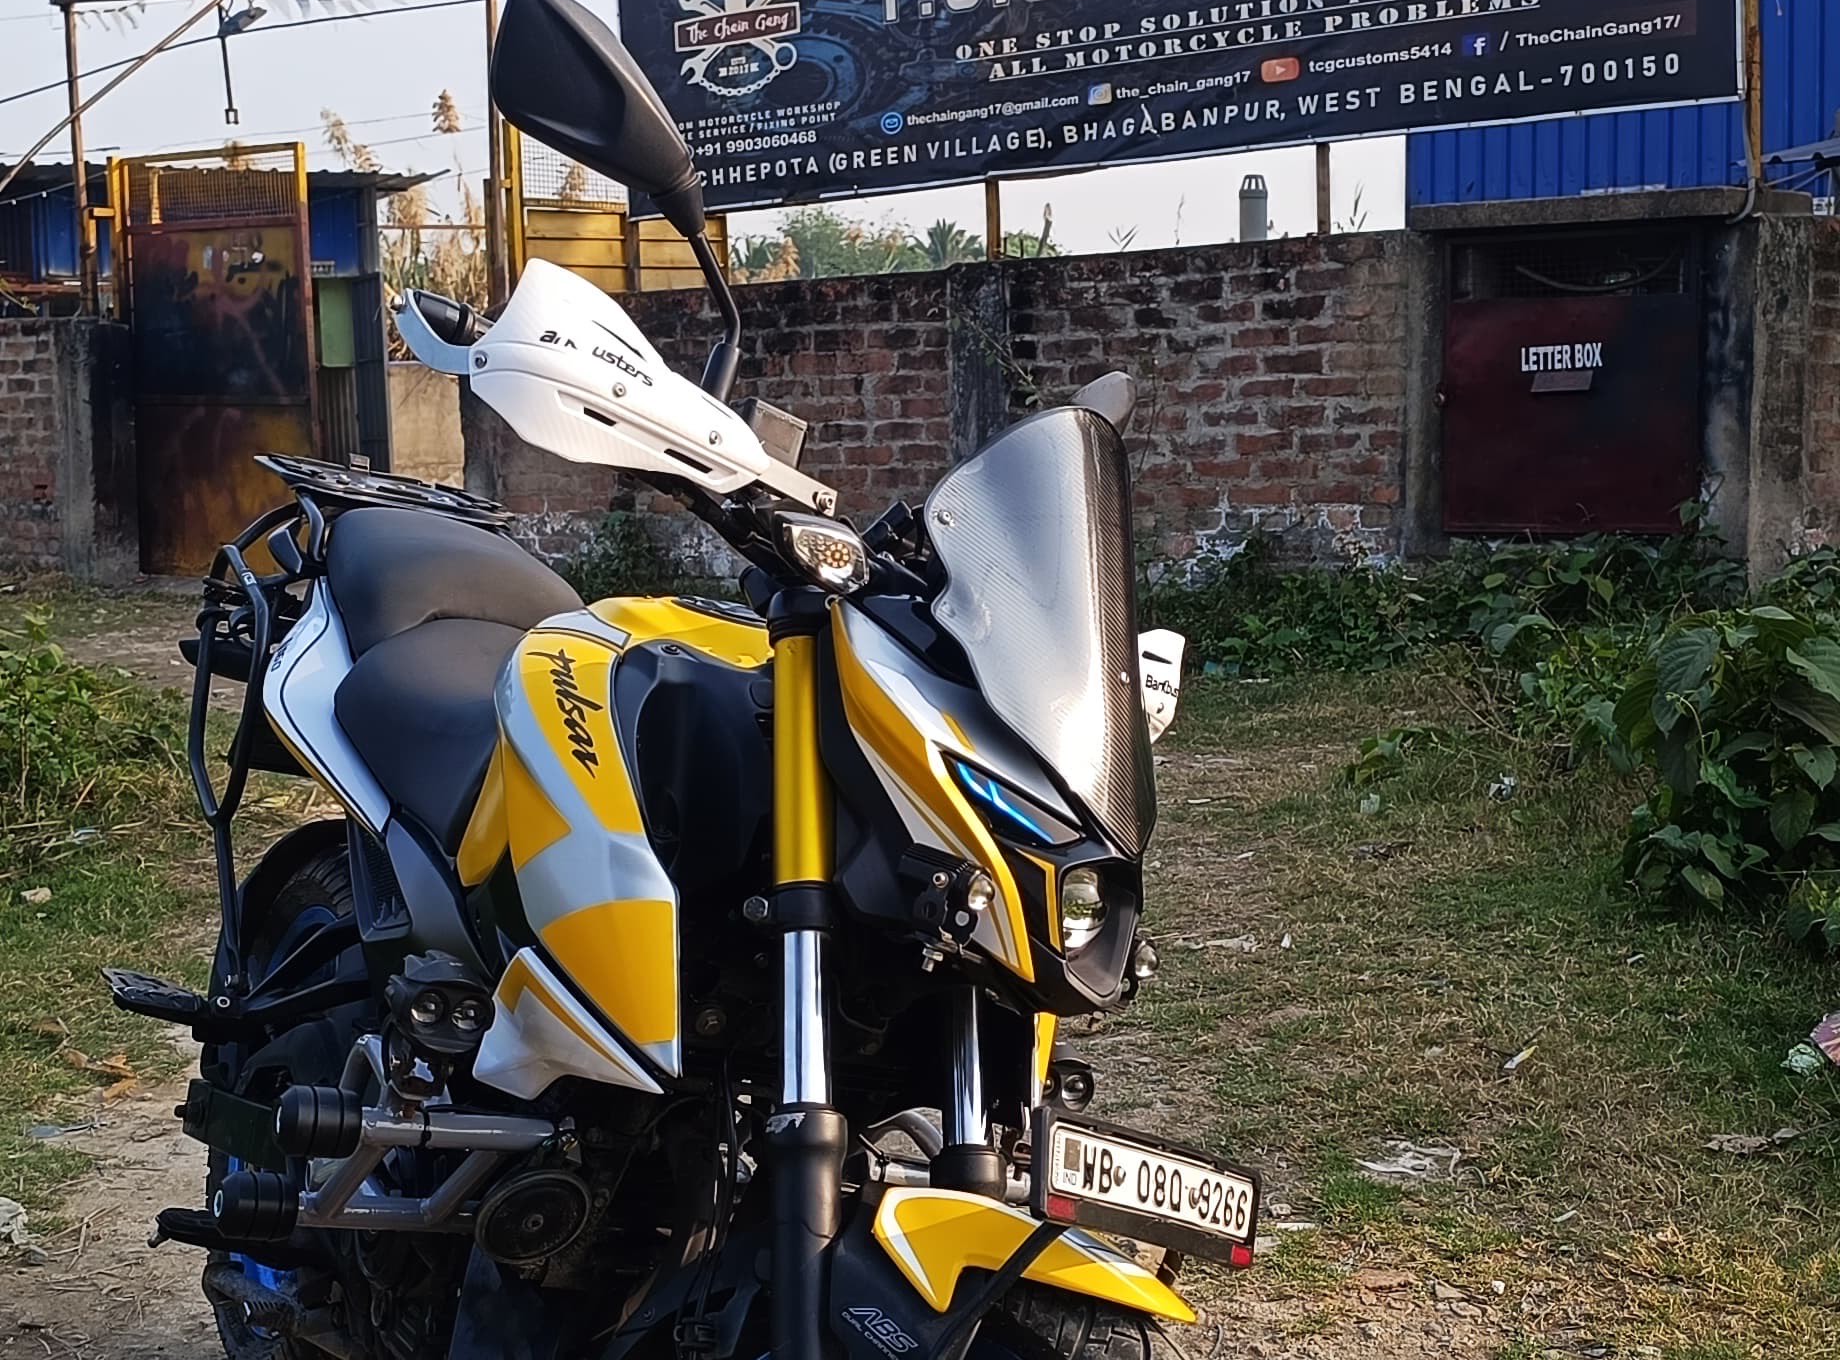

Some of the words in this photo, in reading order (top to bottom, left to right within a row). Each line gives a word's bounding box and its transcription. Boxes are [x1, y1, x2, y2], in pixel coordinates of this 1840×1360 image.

[685, 22, 709, 45] The
[955, 37, 1018, 60] ONE
[1036, 22, 1121, 49] STOP
[989, 56, 1047, 80] ALL
[1065, 20, 1302, 69] MOTORCYCLE
[907, 95, 1079, 127] thechaingang17@gmail.com
[1116, 70, 1251, 100] the_chain_gang17
[1308, 42, 1452, 73] tcgcustoms5414
[699, 110, 771, 128] MOTORCYCLE
[776, 101, 841, 117] WORKSHOP
[801, 112, 836, 125] POINT
[828, 143, 917, 175] (GREEN
[926, 127, 1053, 160] VILLAGE),
[1063, 99, 1286, 143] BHAGABANPUR,
[1298, 87, 1381, 116] WEST
[1399, 53, 1680, 104] BENGAL-700150
[695, 142, 721, 156] +91
[726, 130, 817, 154] 9903060468
[1521, 345, 1572, 372] LETTER
[1574, 342, 1603, 368] BOX
[525, 648, 604, 780] pulsar
[1082, 1143, 1113, 1194] WB
[1199, 1178, 1248, 1231] 9266
[848, 1307, 919, 1353] ABS
